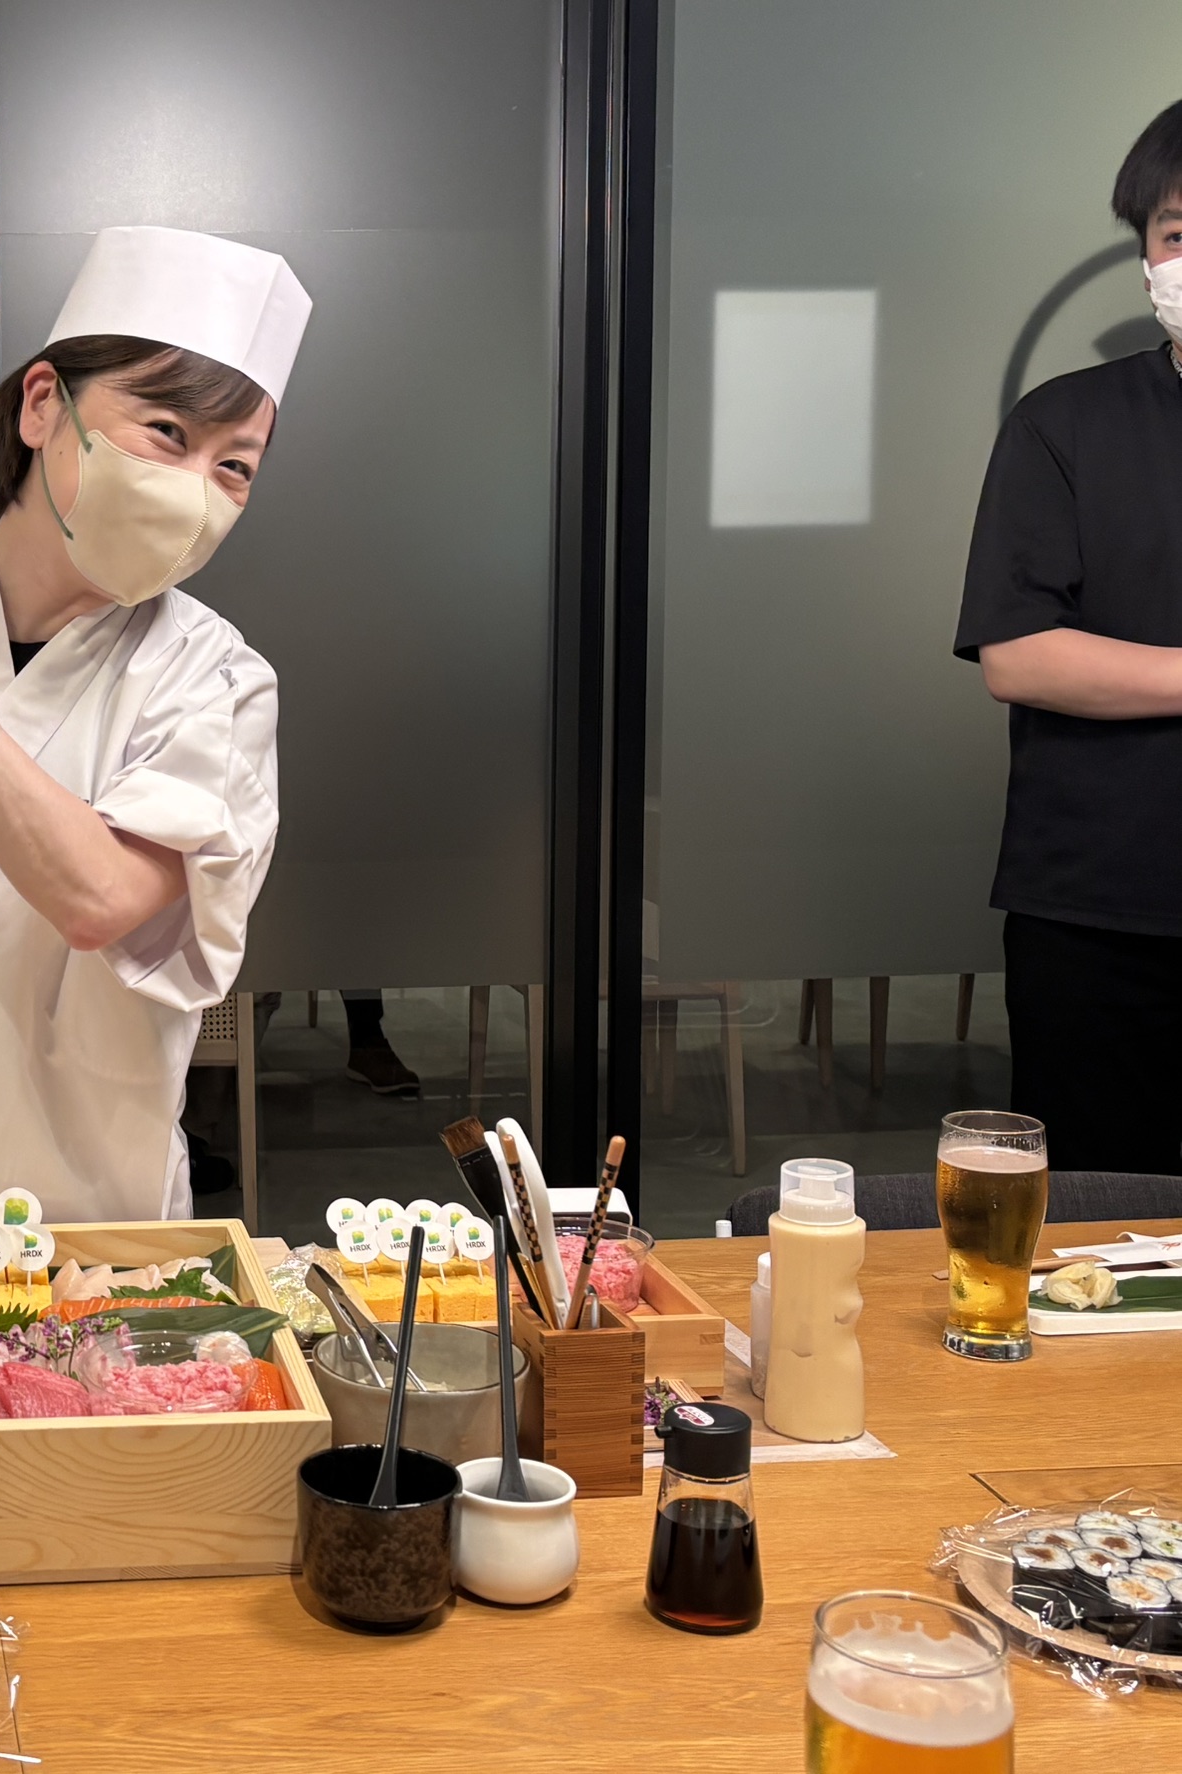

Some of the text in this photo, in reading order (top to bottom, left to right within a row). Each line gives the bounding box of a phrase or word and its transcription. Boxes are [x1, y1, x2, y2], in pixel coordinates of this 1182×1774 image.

[349, 1244, 371, 1252] HRDX
[465, 1241, 486, 1249] HRDX
[20, 1250, 43, 1258] HRDX
